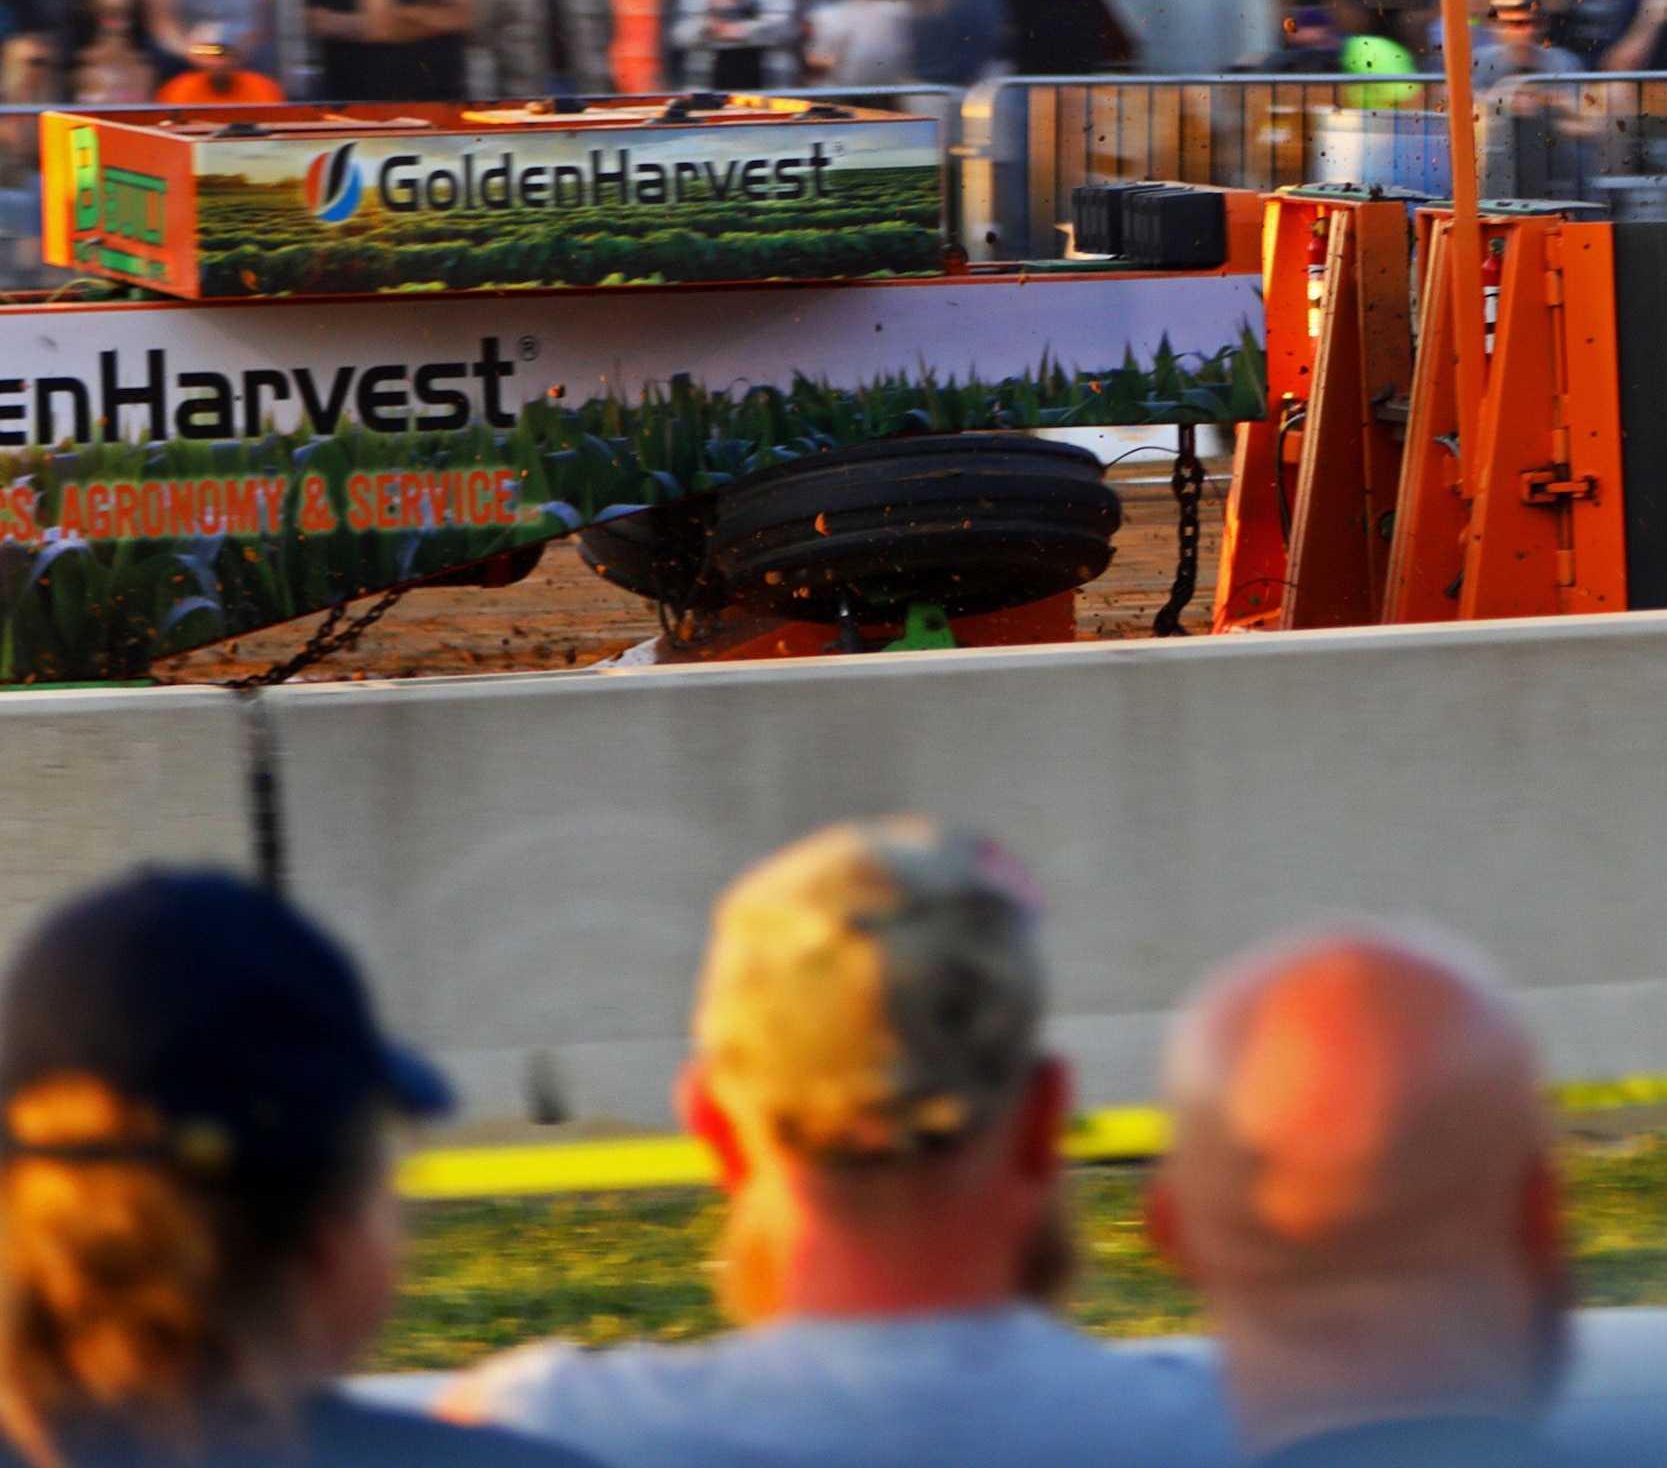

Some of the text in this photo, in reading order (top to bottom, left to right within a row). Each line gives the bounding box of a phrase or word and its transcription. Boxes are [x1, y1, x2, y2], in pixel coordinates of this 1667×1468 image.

[379, 141, 832, 213] GoldenHarvest
[61, 478, 286, 539] AGRONOMY
[301, 475, 336, 532] &
[347, 470, 517, 531] SERVICE
